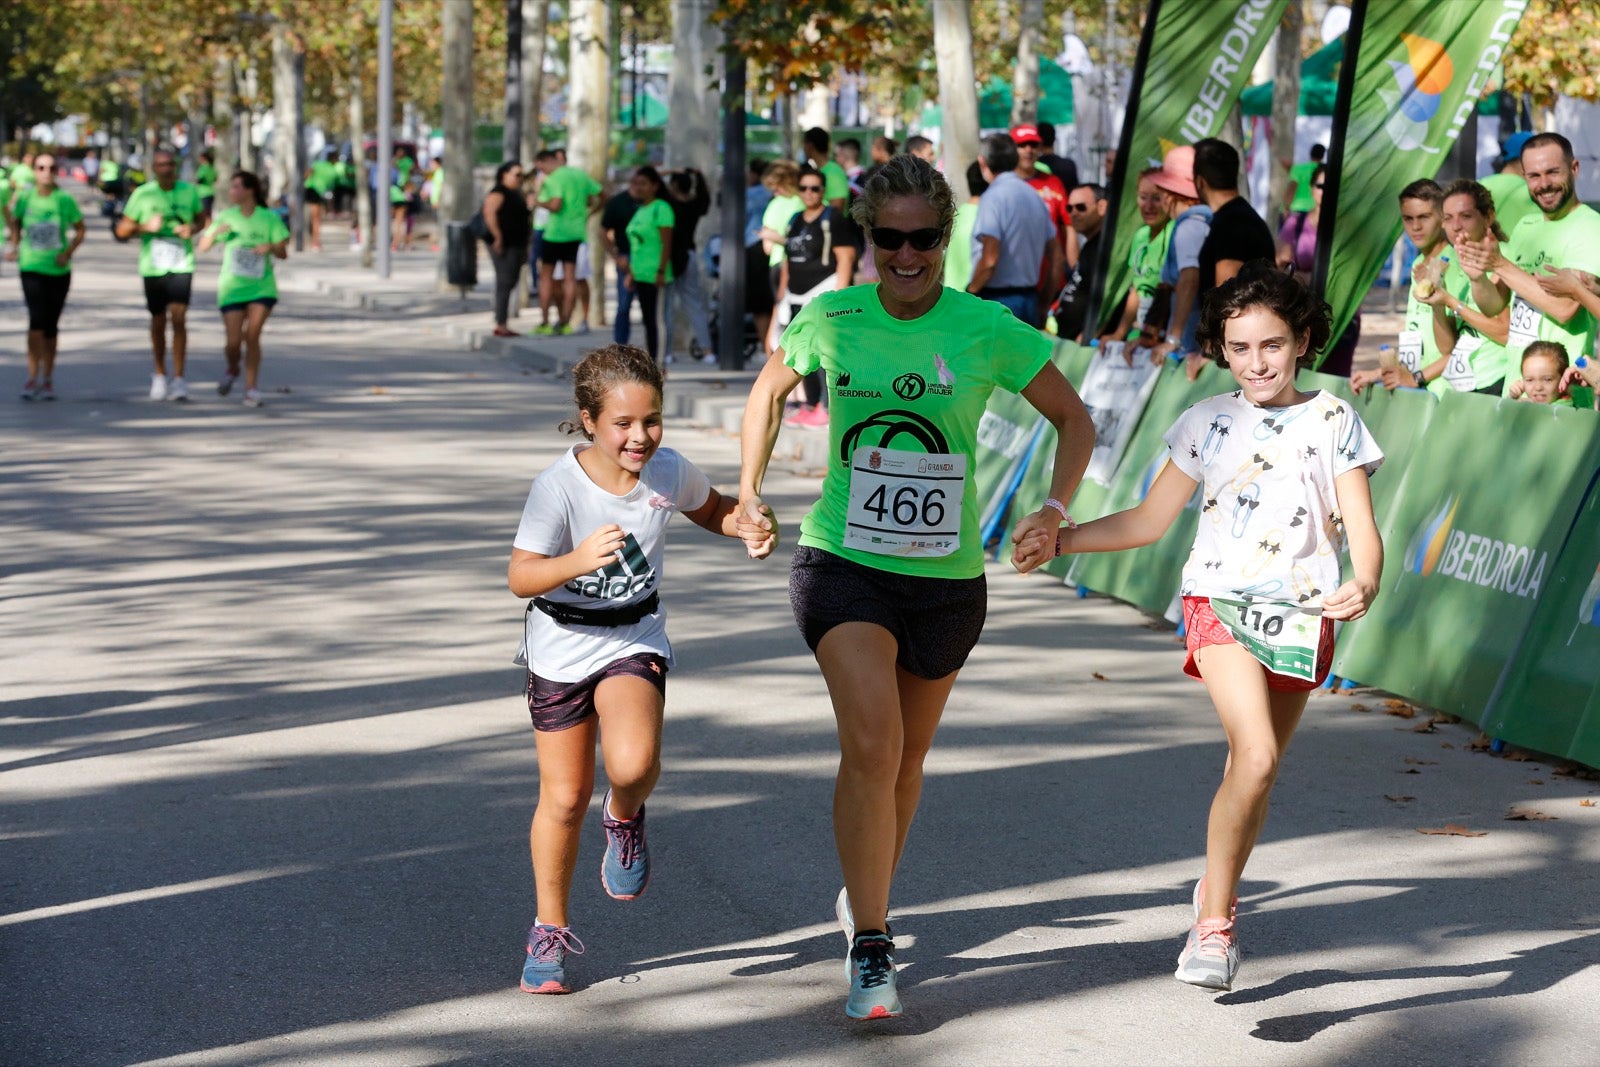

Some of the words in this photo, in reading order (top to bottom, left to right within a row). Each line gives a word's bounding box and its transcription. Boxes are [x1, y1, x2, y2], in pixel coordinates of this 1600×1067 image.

[826, 308, 853, 318] luanvi
[837, 389, 882, 399] IBERDROLA
[927, 388, 953, 396] MUJER
[863, 484, 946, 527] 466
[1437, 528, 1548, 600] IBERDROLA
[1237, 606, 1284, 636] 110
